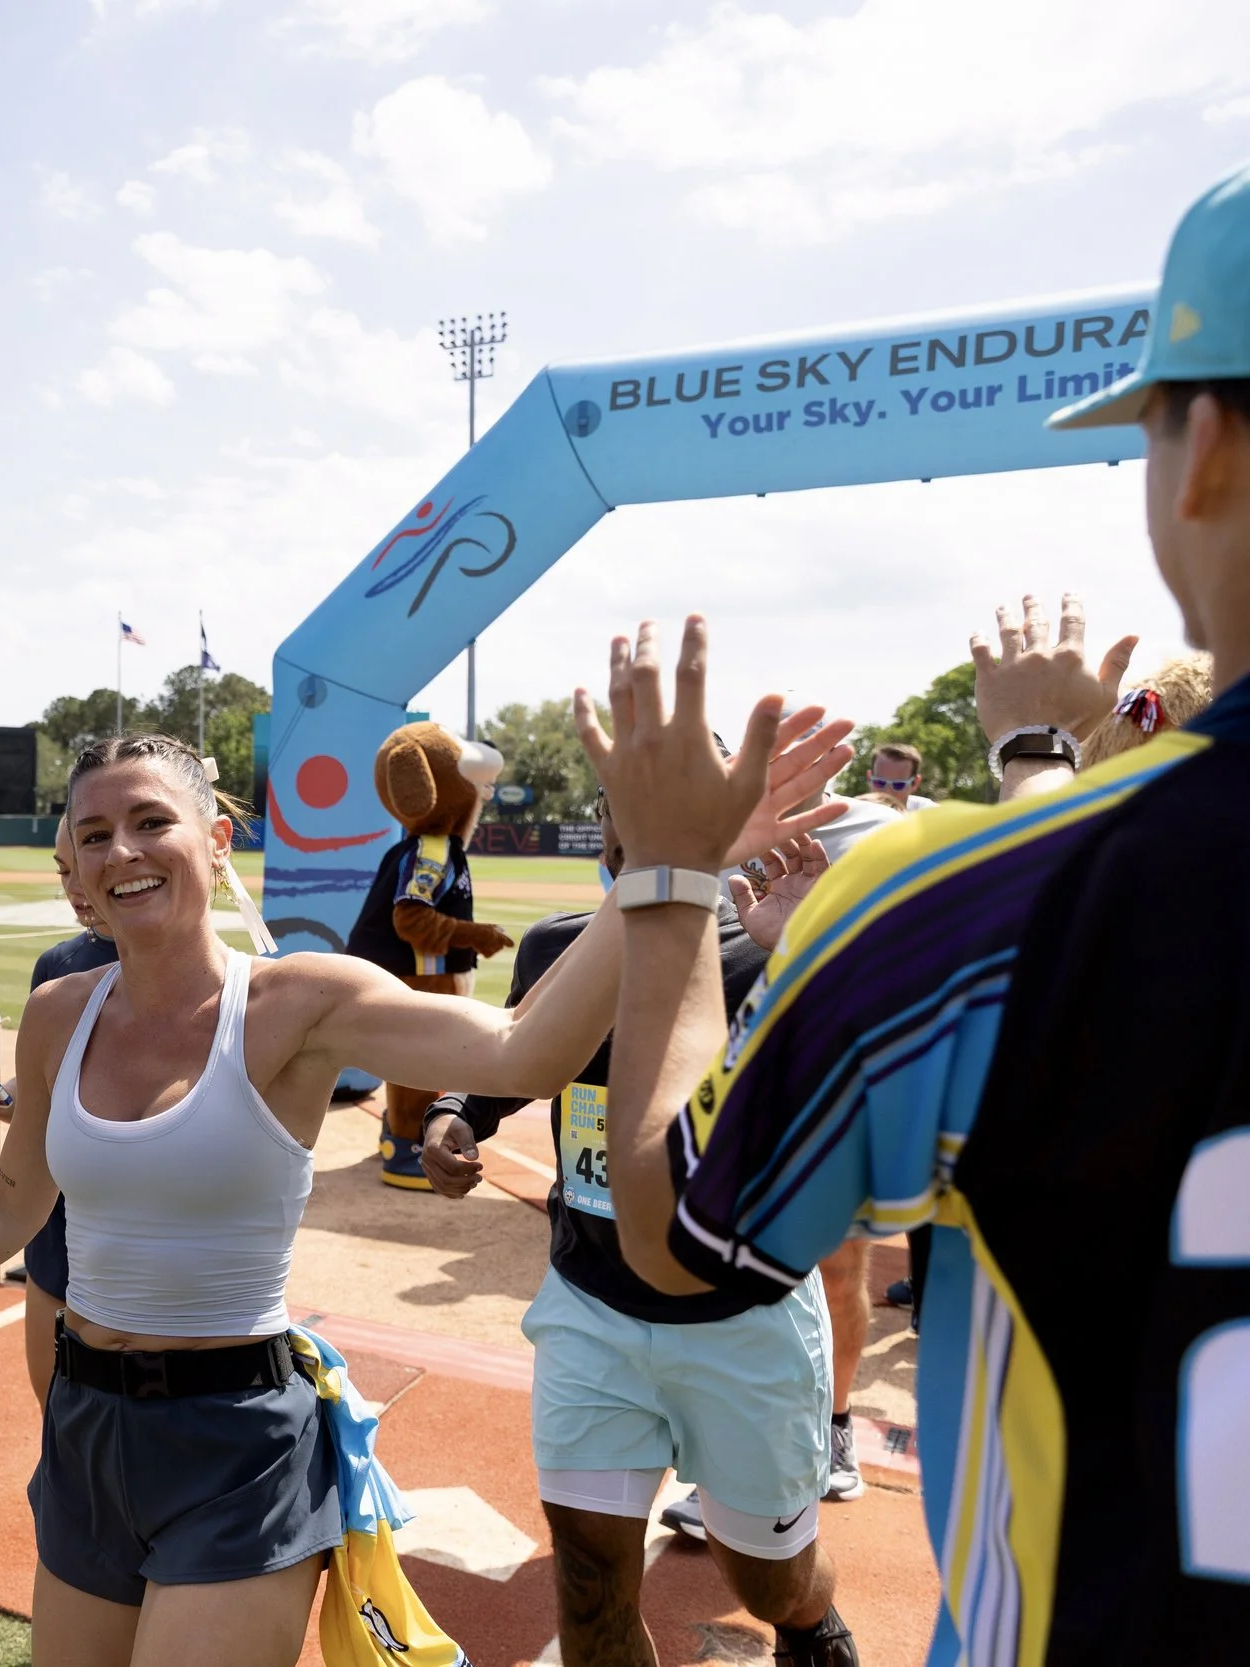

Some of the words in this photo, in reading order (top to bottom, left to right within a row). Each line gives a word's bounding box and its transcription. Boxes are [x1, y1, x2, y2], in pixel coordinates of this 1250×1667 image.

[609, 365, 743, 412] BLUE
[756, 347, 874, 393] SKY
[701, 410, 791, 439] Your
[802, 397, 887, 428] Sky.
[900, 383, 1003, 416] Your
[571, 1086, 597, 1102] RUN
[570, 1113, 595, 1130] RUN
[596, 1118, 607, 1132] 5
[577, 1195, 592, 1207] ONE
[592, 1198, 613, 1212] BEER
